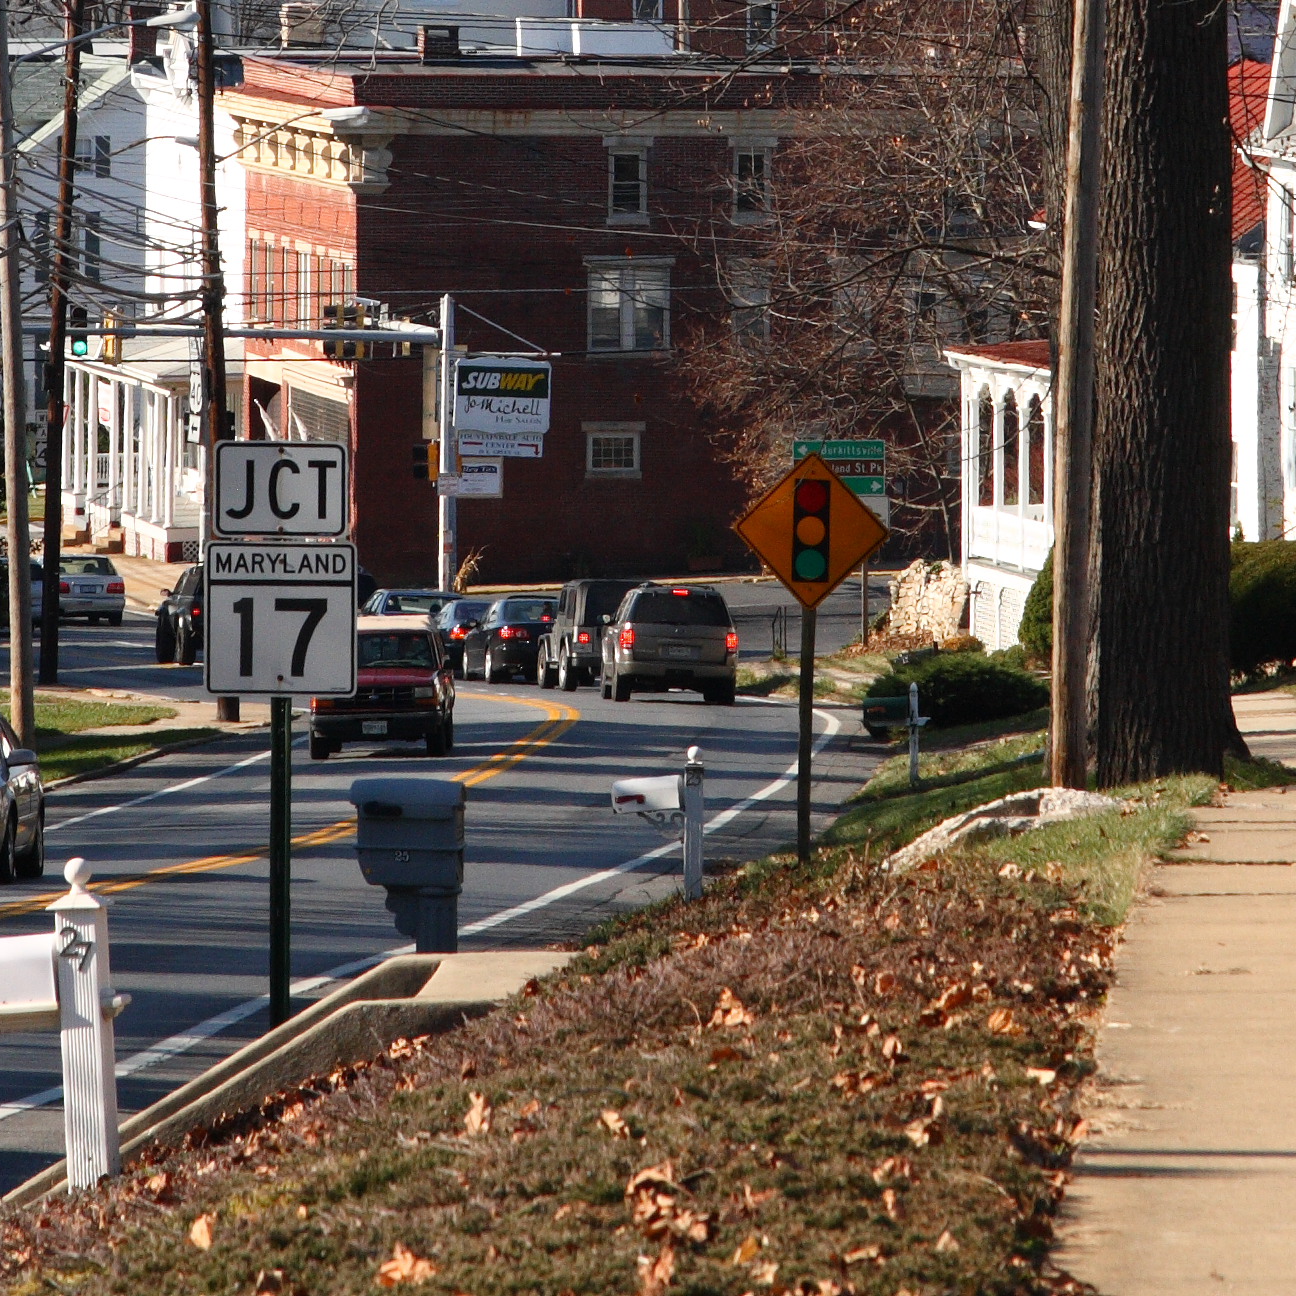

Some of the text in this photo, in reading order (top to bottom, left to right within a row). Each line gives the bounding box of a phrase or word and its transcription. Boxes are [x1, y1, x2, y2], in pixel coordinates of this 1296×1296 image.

[462, 371, 545, 391] SUBWAY
[870, 463, 882, 473] Pk
[225, 459, 337, 520] JCT
[215, 552, 346, 574] MARYLAND
[233, 597, 328, 677] 17
[394, 850, 410, 863] 25
[59, 926, 93, 973] 27
